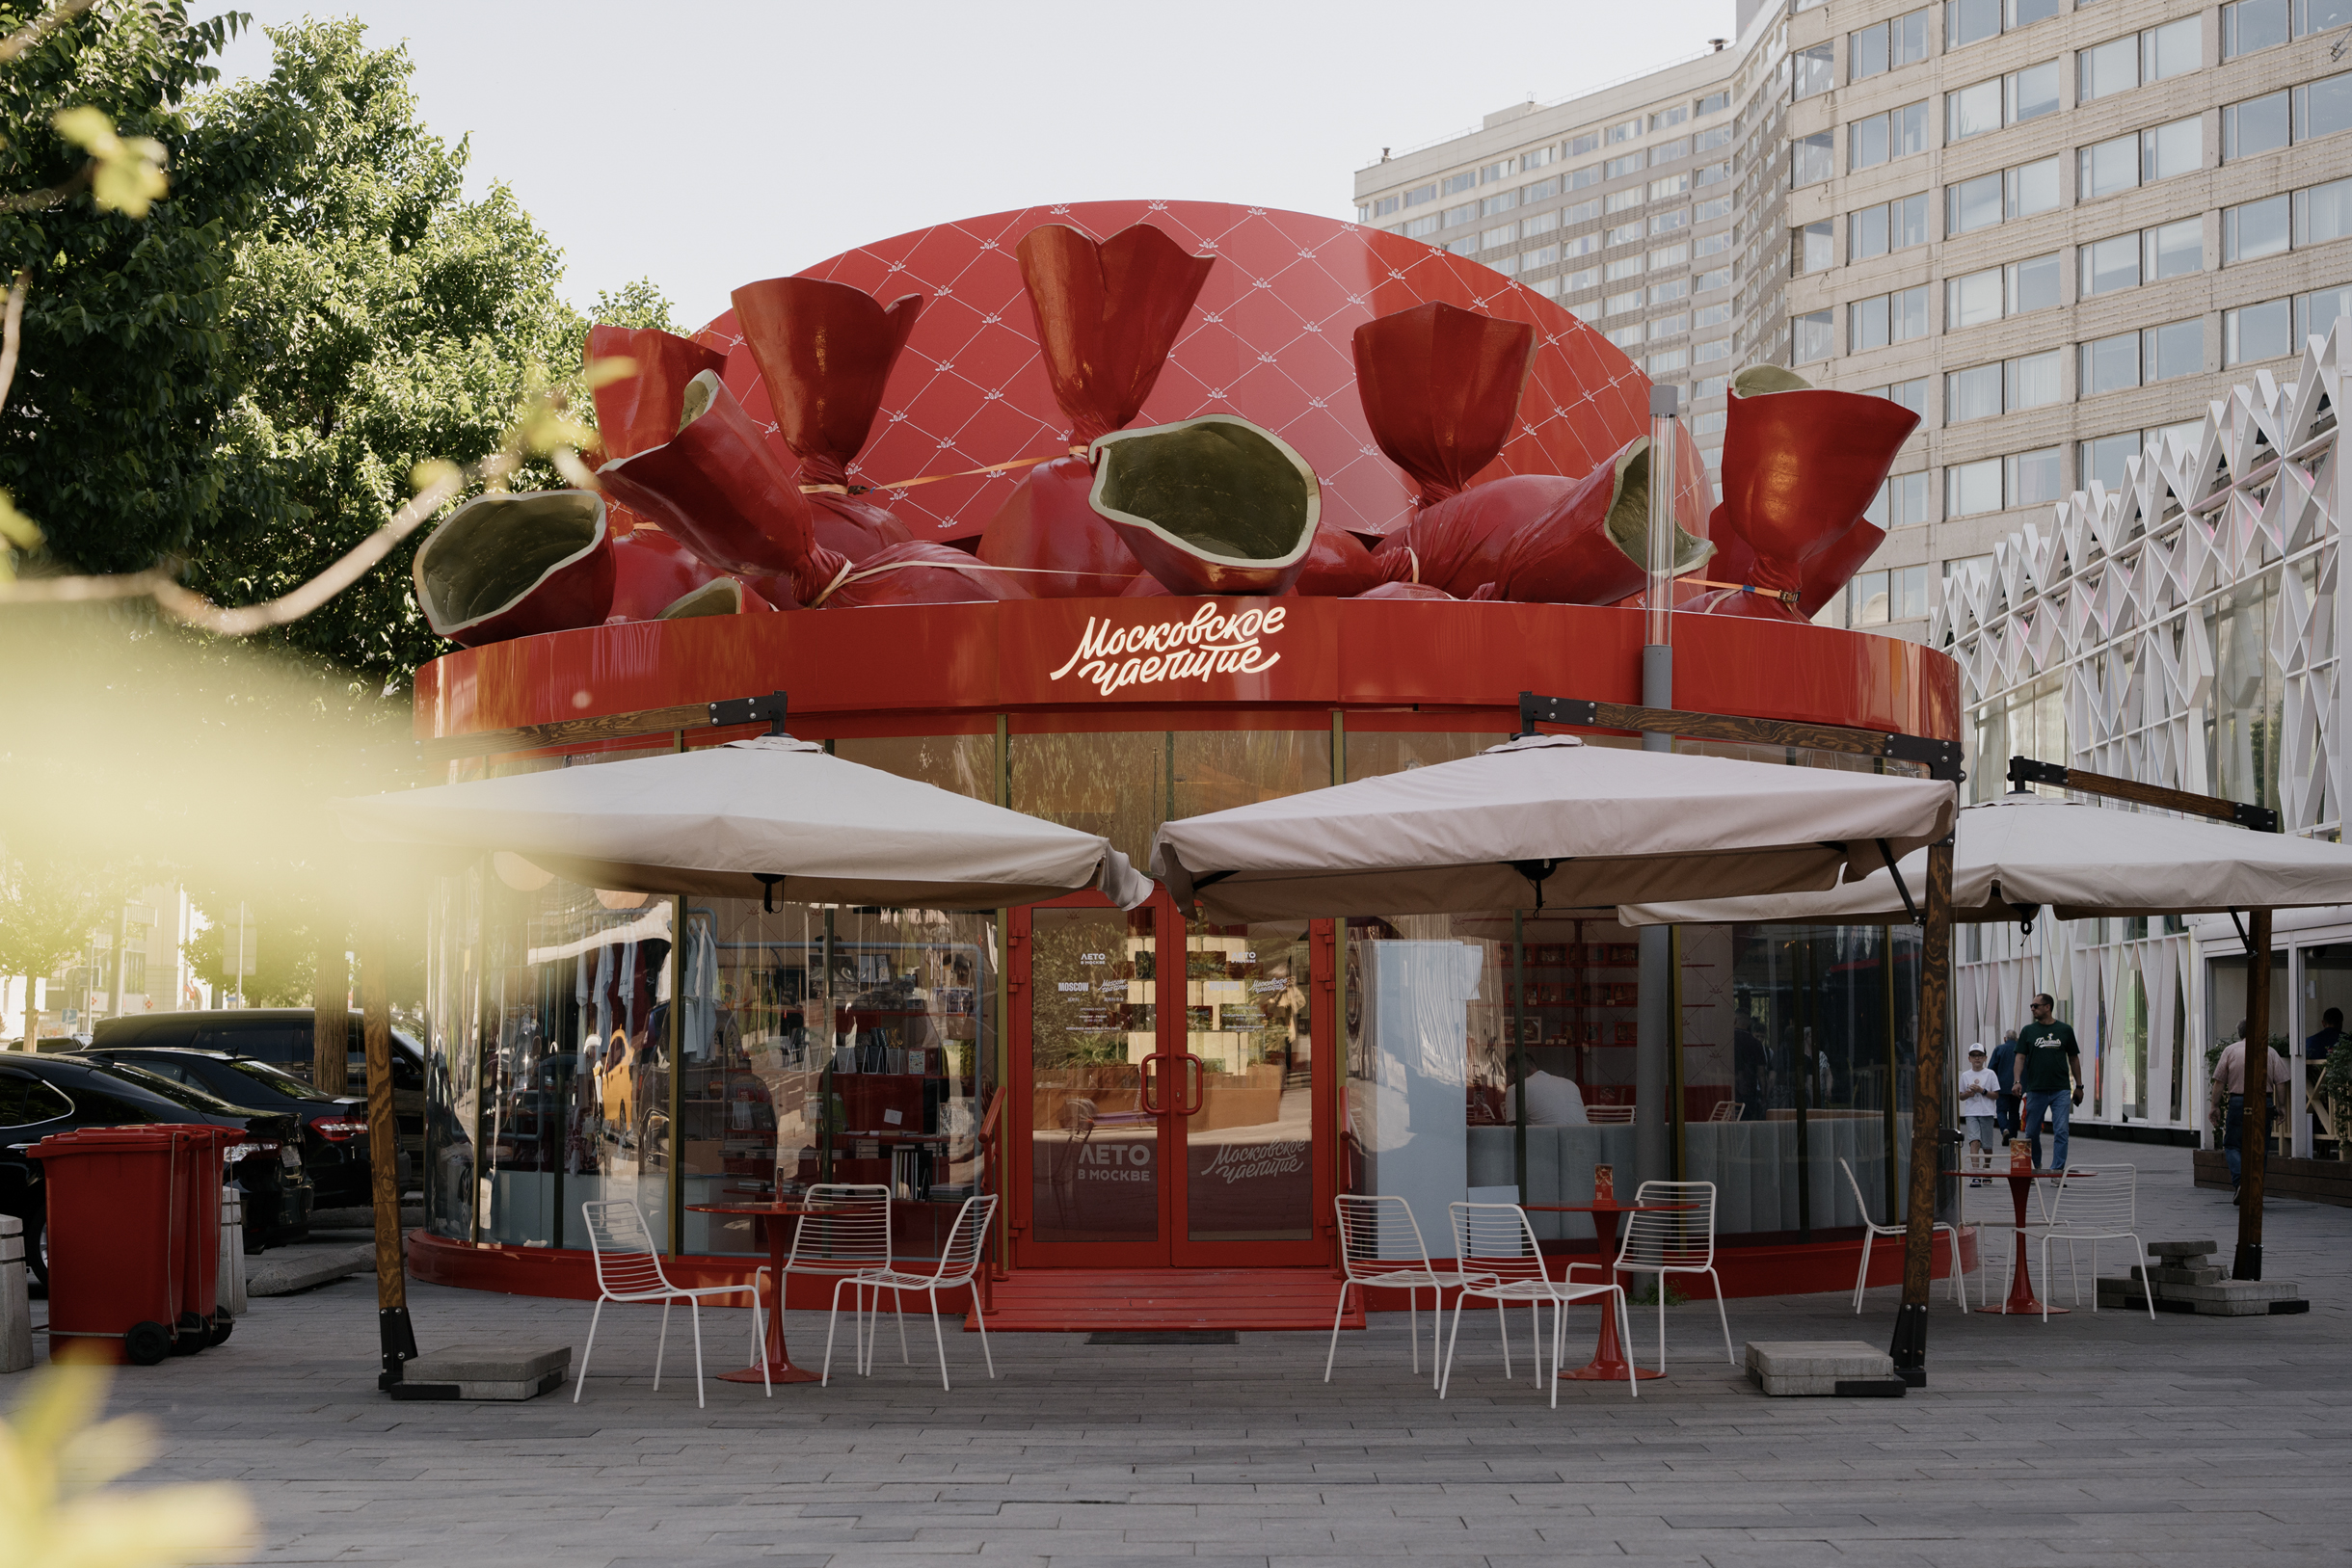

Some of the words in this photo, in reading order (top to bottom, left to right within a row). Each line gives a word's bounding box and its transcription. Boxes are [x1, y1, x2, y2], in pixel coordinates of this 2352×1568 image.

[1050, 601, 1286, 680] Московское
[1058, 982, 1088, 992] MOSCOW
[1098, 979, 1126, 990] Moscow
[1209, 981, 1240, 991] МОСКВА
[1248, 977, 1288, 991] Московское
[1078, 1144, 1151, 1166] ЛЕТО
[1201, 1135, 1306, 1176] Московское
[1078, 1168, 1086, 1181] В
[1089, 1169, 1150, 1182] МОСКВЕ
